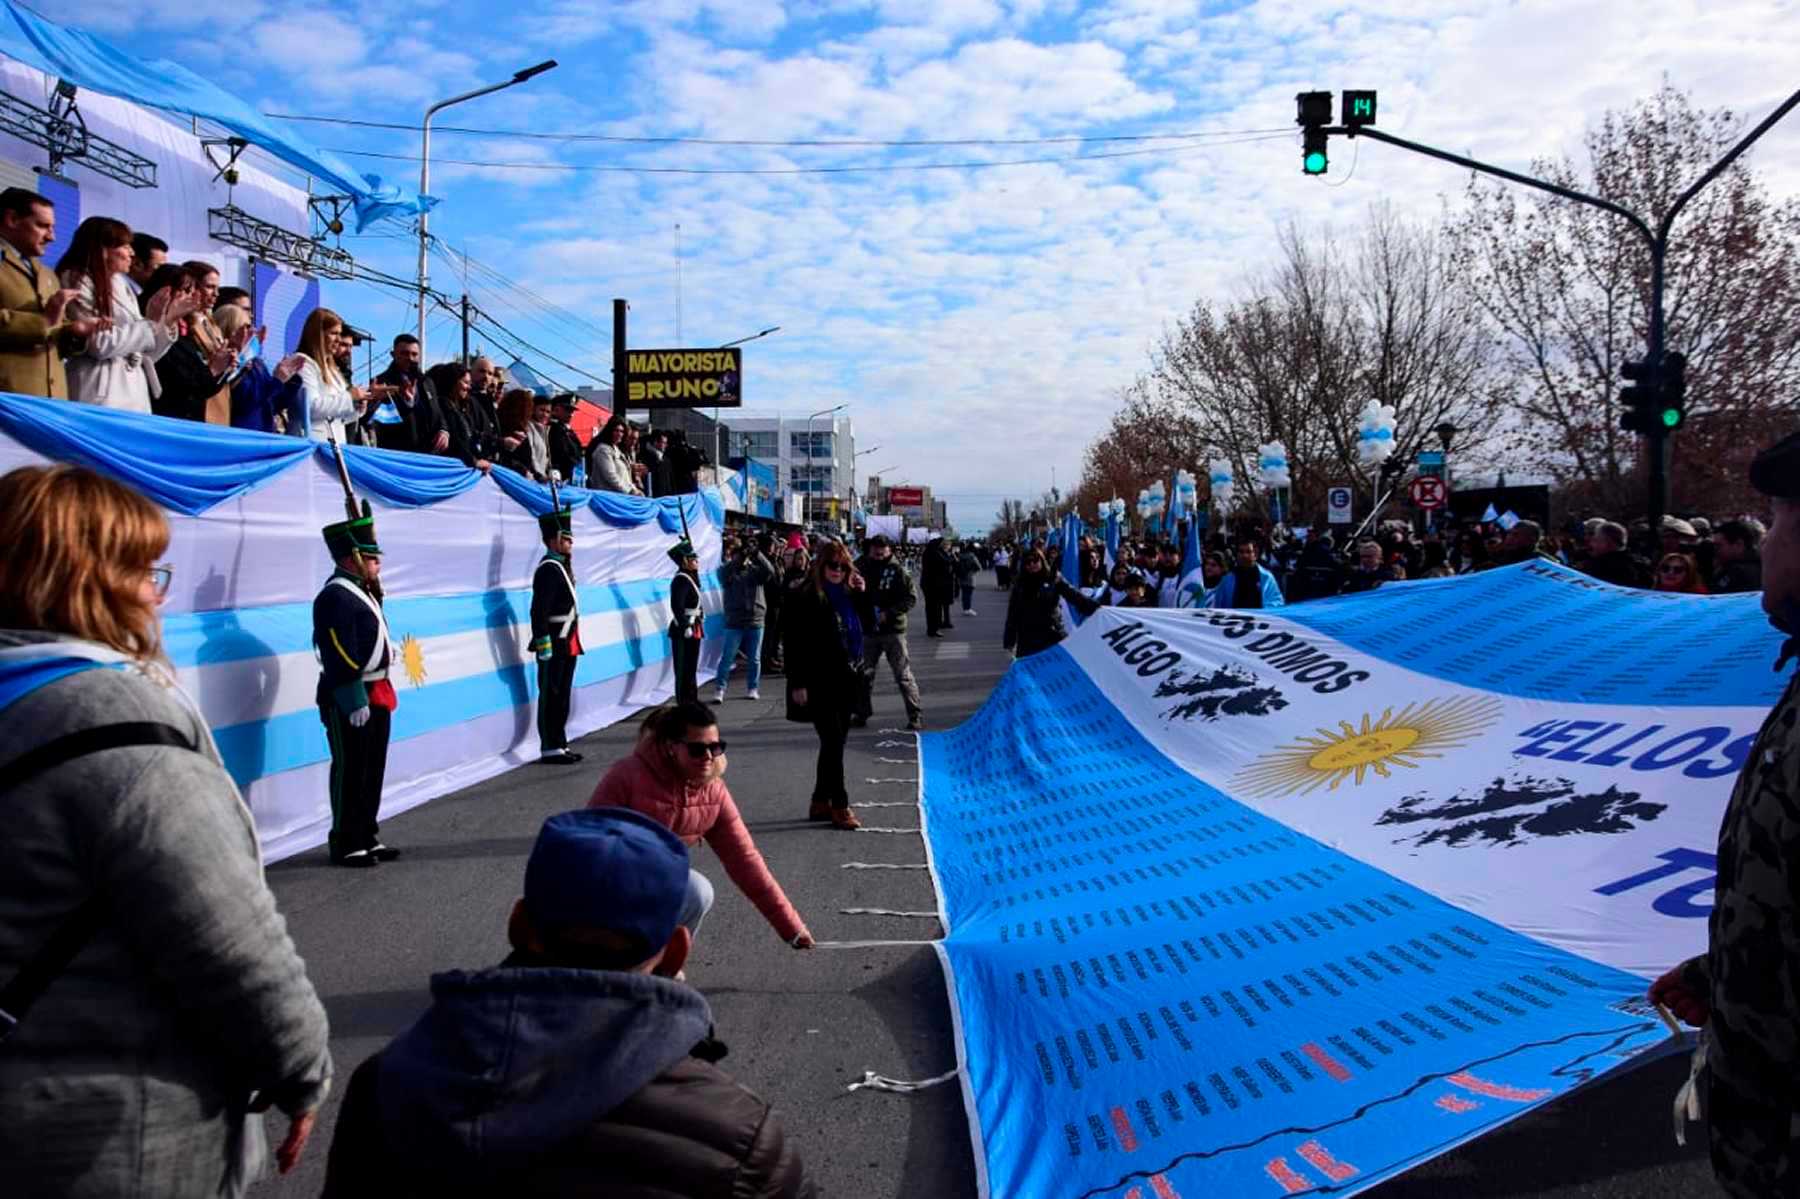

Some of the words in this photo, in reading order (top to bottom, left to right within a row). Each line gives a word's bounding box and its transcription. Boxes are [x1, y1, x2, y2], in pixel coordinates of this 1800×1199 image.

[1354, 98, 1370, 115] 14
[628, 352, 737, 373] MAYORISTA
[628, 379, 718, 400] BRUNO
[1101, 621, 1182, 677] ALGO
[1243, 631, 1370, 693] DIMOS
